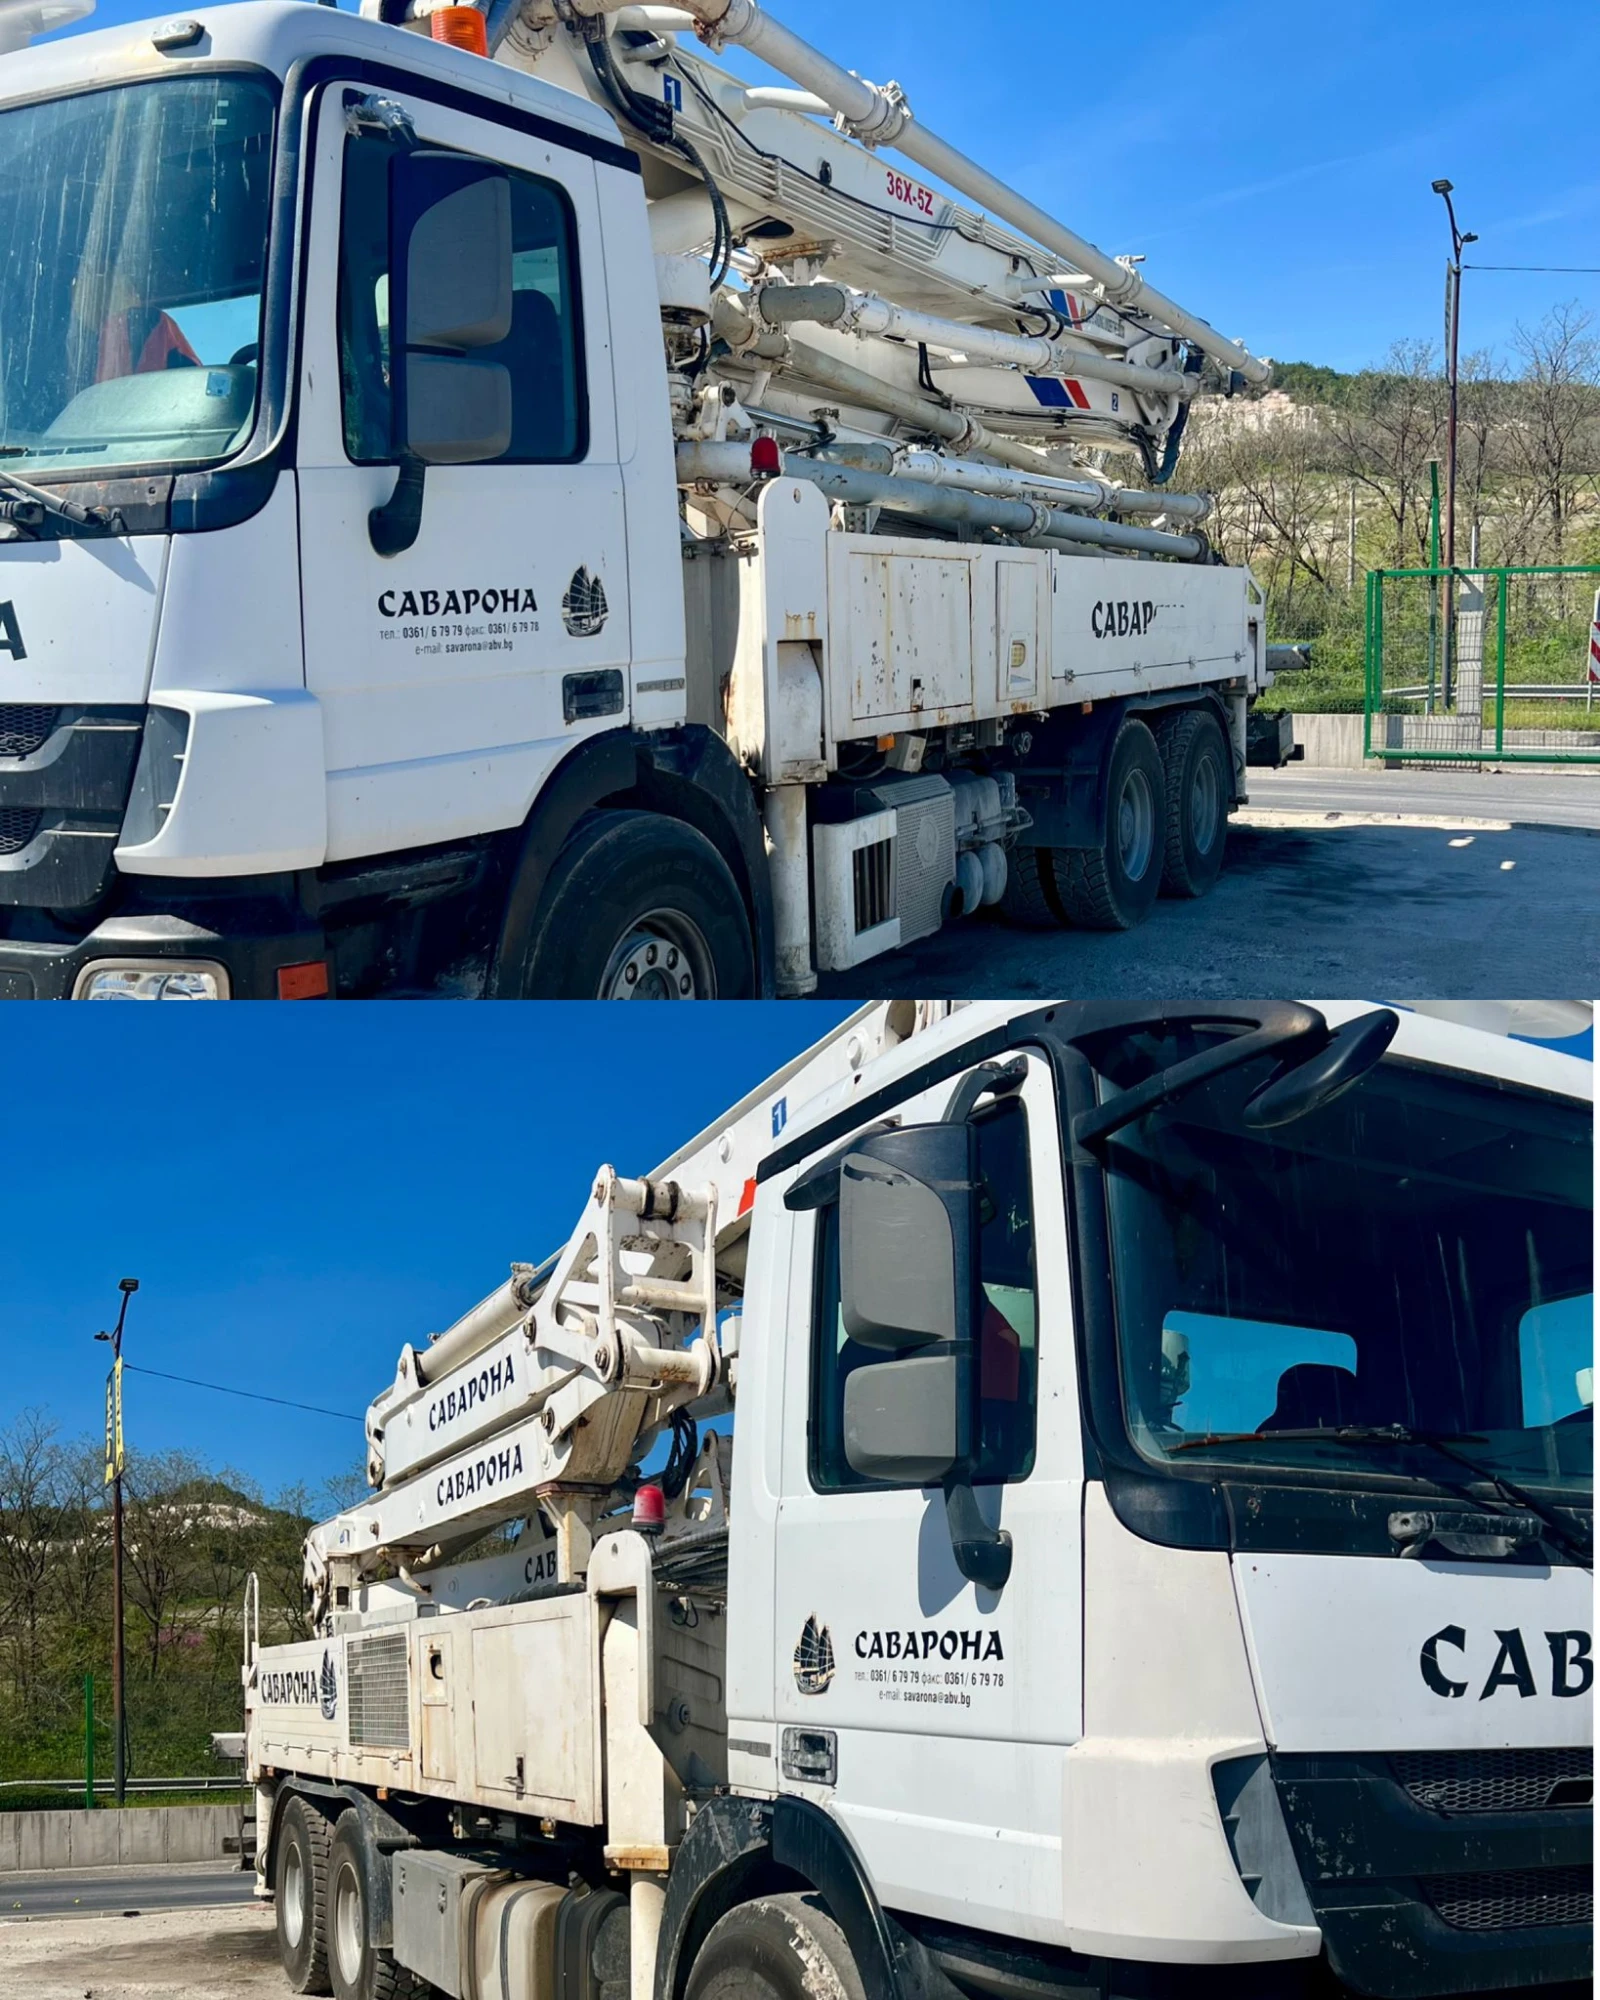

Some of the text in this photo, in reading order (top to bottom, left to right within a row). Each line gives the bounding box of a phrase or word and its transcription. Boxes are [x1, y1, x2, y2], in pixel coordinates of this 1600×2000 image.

[886, 171, 934, 217] 36X-5Z
[377, 588, 539, 618] САВАРОНА
[1091, 600, 1185, 639] САВАР
[445, 638, 513, 654] savarona@abv.bg
[428, 1353, 515, 1432] САВАРОНА
[436, 1443, 523, 1507] САВАРОНА
[854, 1629, 1005, 1662] САВАРОНА
[261, 1669, 319, 1705] САВАРОНА
[903, 1690, 971, 1709] savarona@abv.bg
